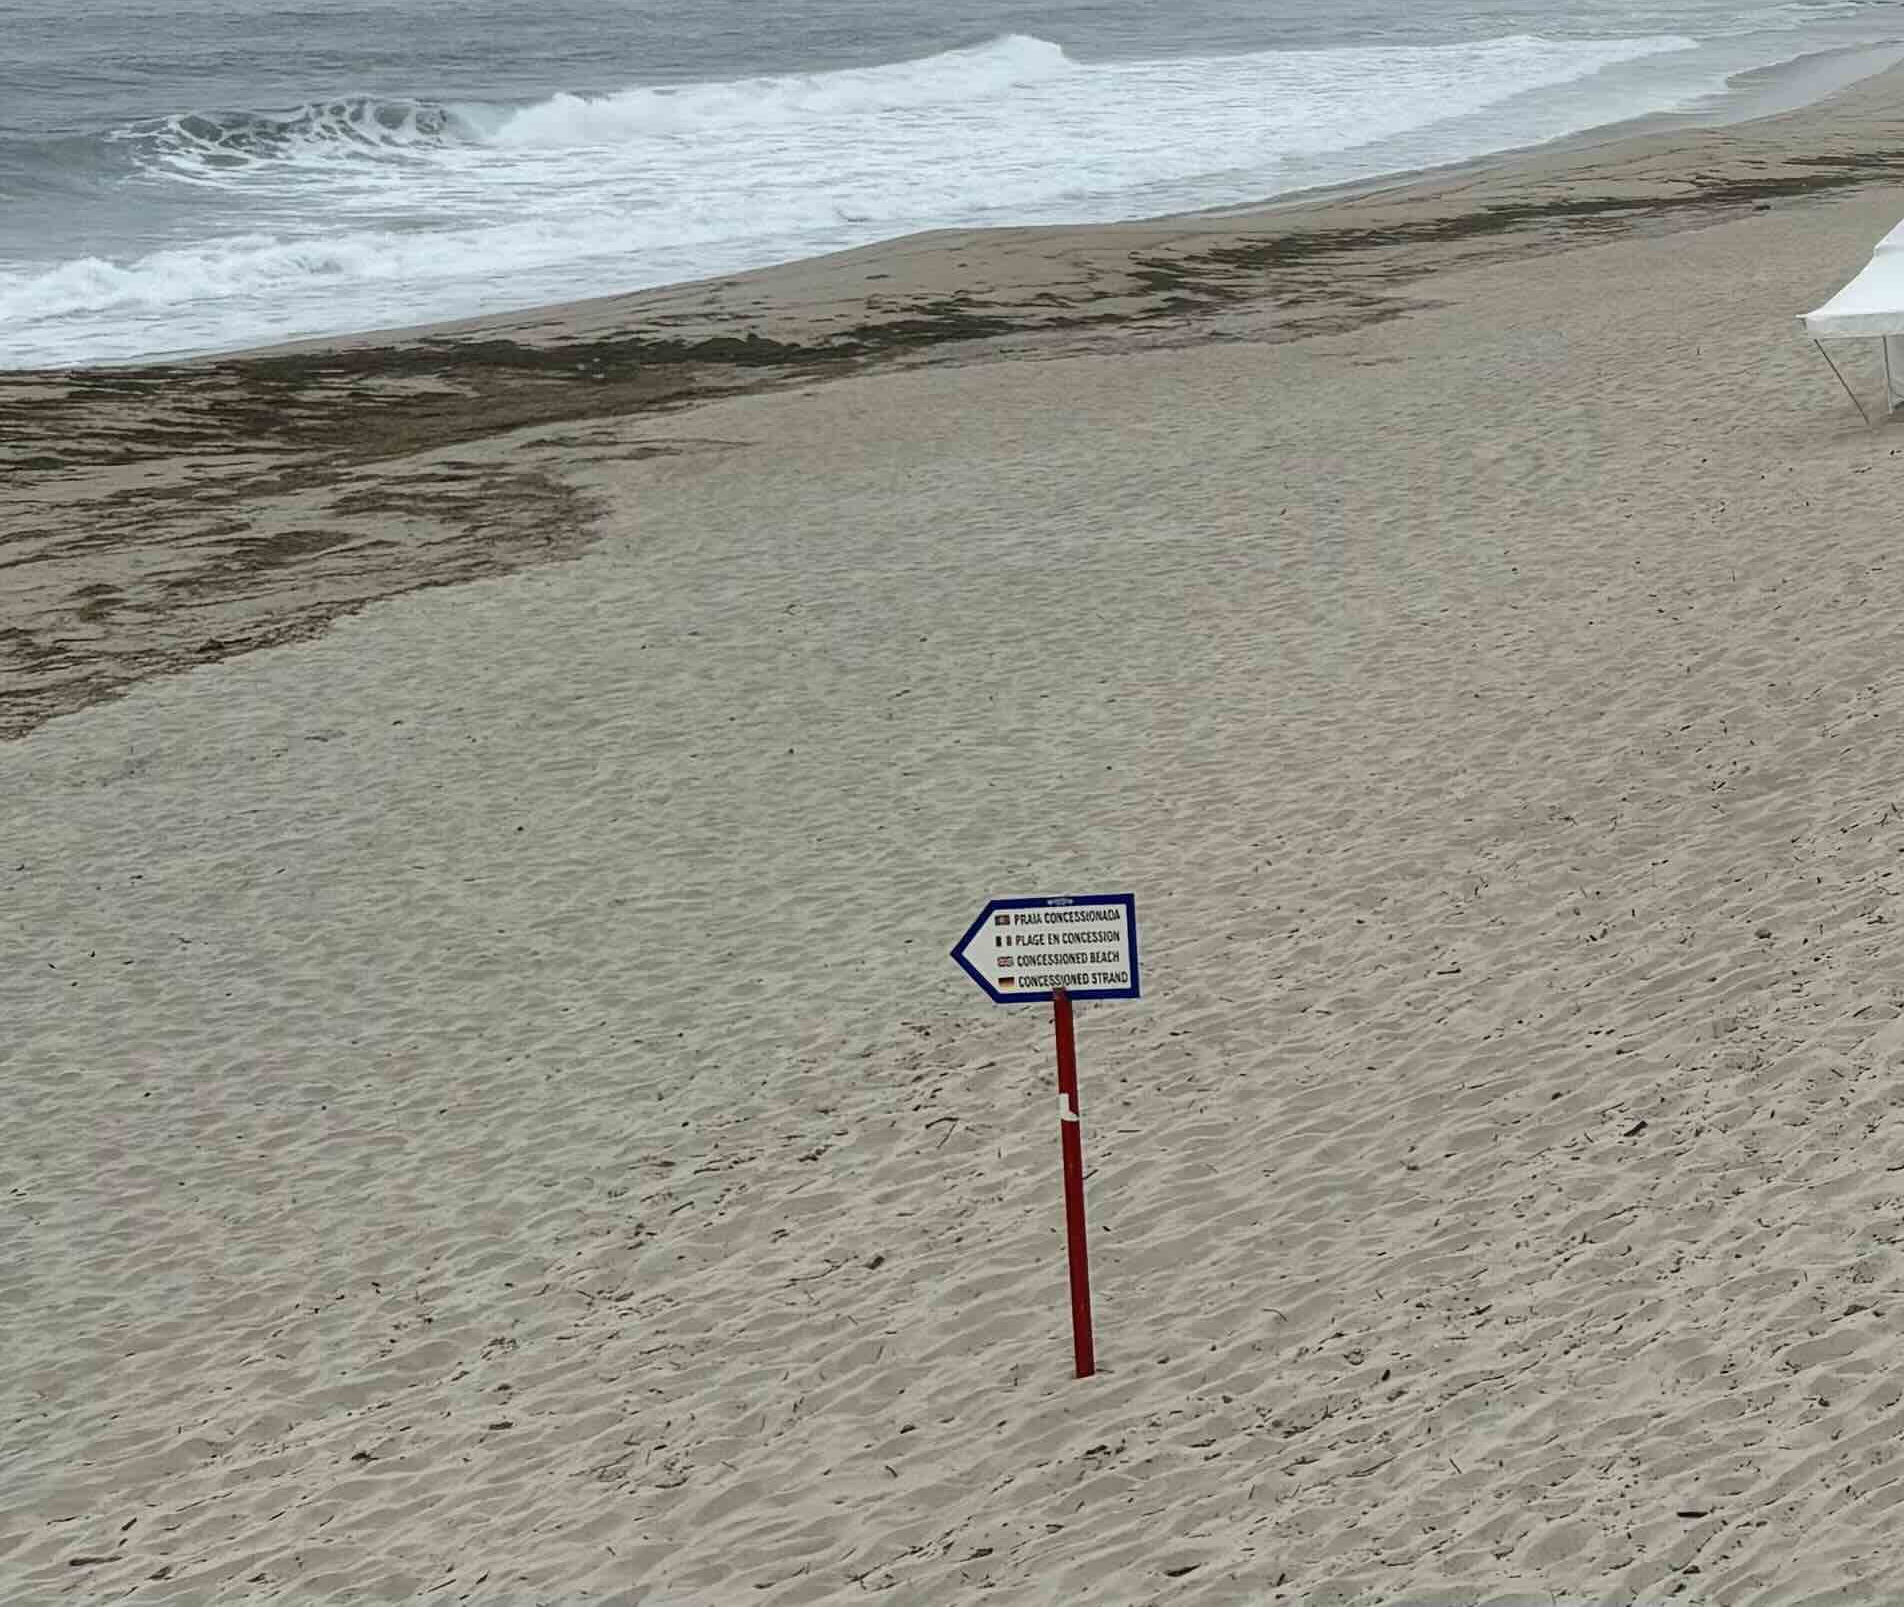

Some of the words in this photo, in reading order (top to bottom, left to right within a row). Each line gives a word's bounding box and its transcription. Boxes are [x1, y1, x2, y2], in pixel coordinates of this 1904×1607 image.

[1014, 913, 1042, 926] PRAIA
[1044, 908, 1121, 924] CONCESSIONADA
[1015, 933, 1045, 947] PLAGE
[1047, 933, 1060, 945] EN
[1062, 930, 1120, 945] CONCESSION
[1016, 952, 1088, 967] CONCESSIONED
[1090, 950, 1120, 964] BEACH
[1018, 973, 1089, 988] CONCESSIONED
[1091, 971, 1129, 985] STRAND
